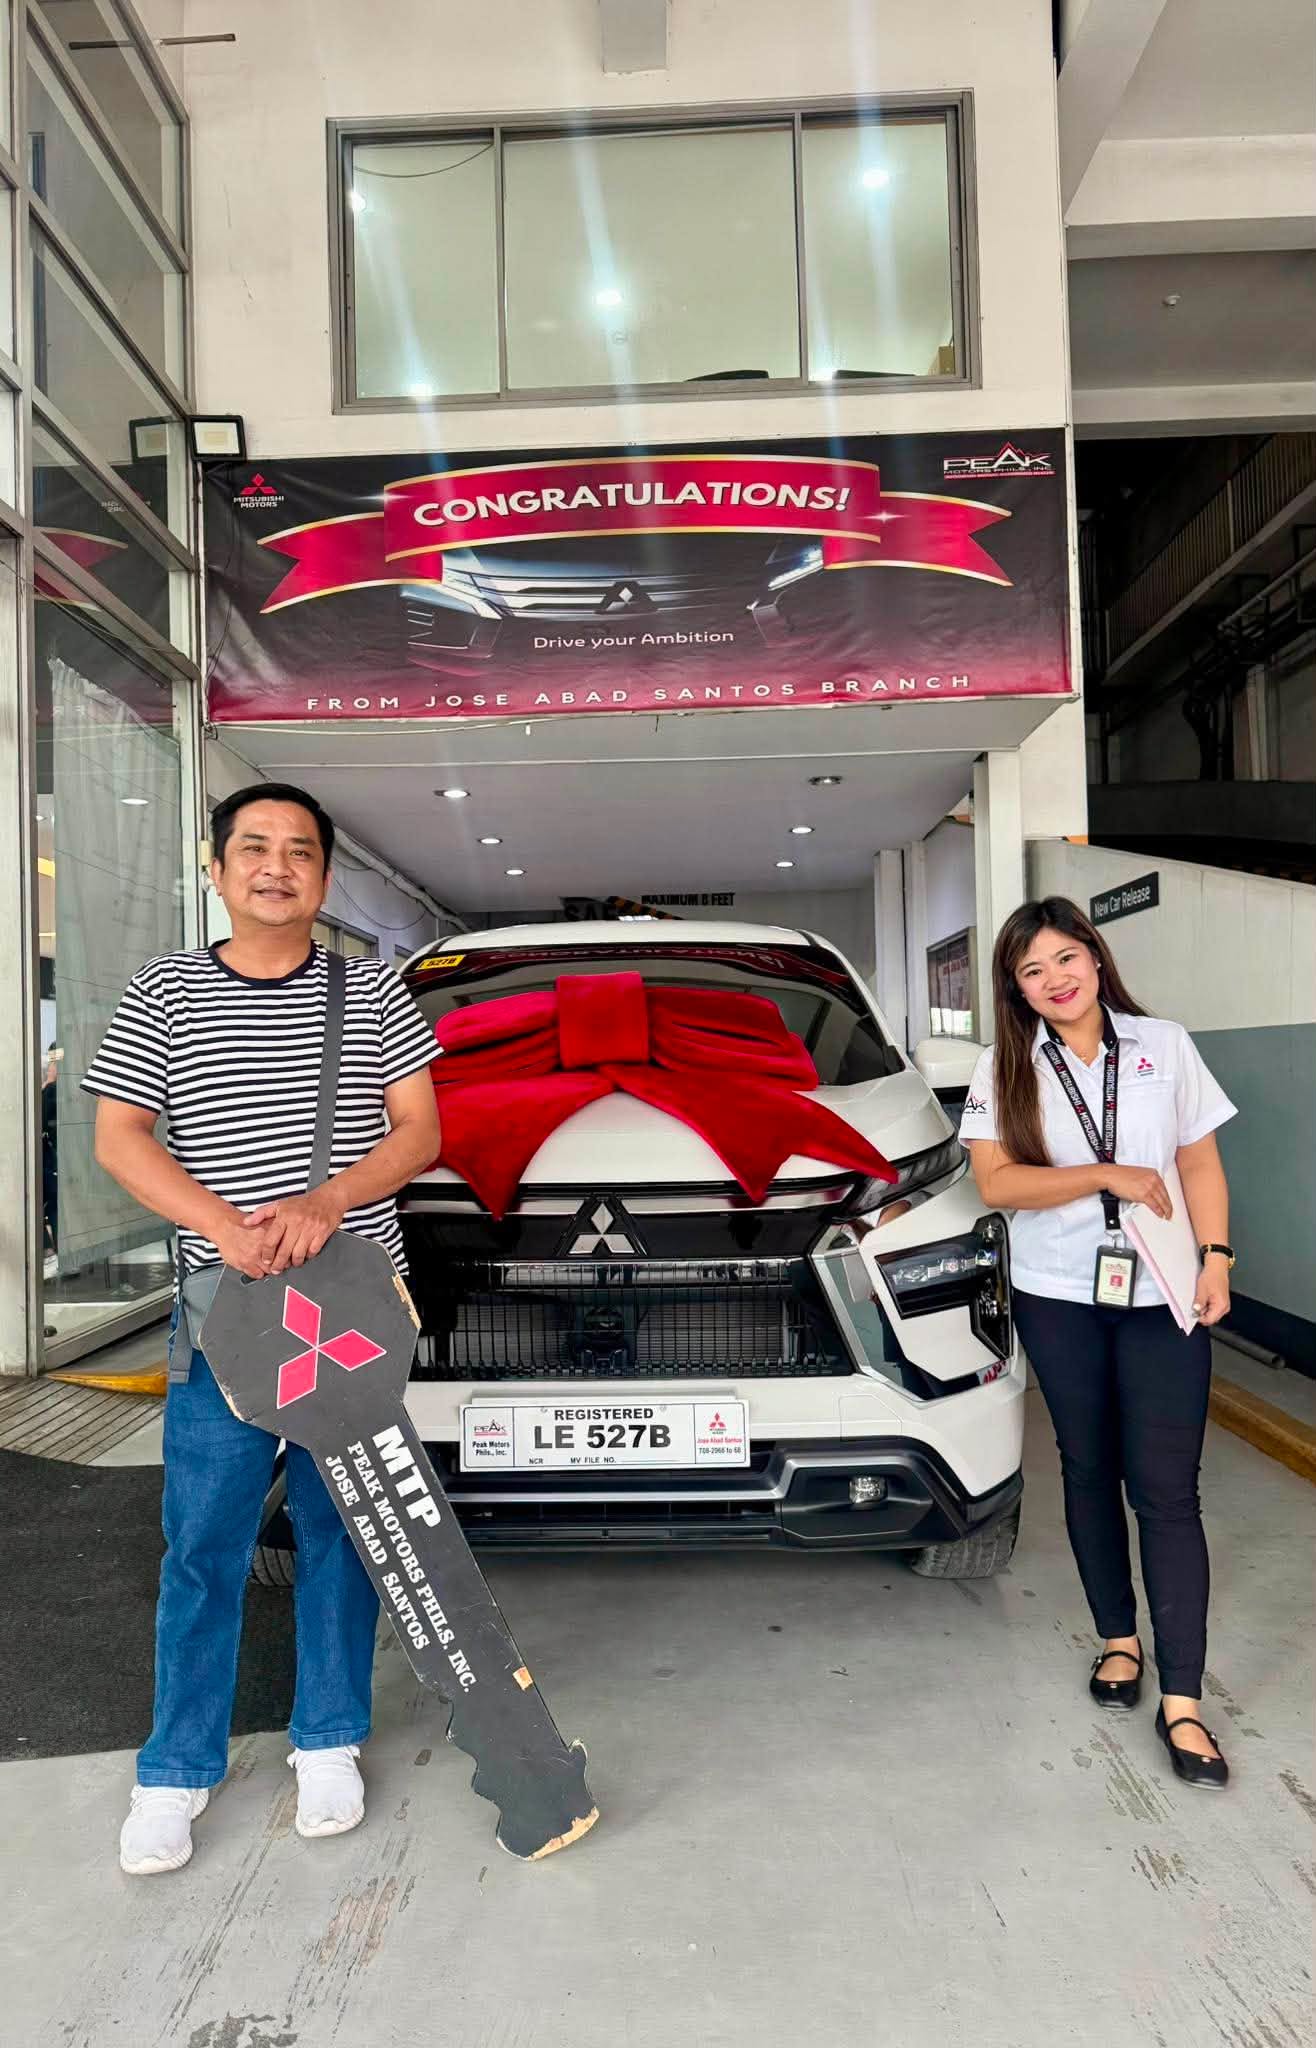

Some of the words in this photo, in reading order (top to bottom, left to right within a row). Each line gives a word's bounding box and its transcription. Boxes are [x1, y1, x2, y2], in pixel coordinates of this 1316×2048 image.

[943, 448, 1052, 471] PEAK
[233, 495, 285, 503] MITSUBISHI
[240, 501, 278, 509] MOTORS
[413, 481, 850, 527] CONGRATULATIONS!
[534, 635, 585, 649] Drive
[590, 636, 636, 649] your
[641, 631, 734, 646] Ambition
[307, 695, 399, 711] FROM
[425, 692, 509, 707] JOSE
[534, 689, 627, 705] ABAD
[654, 683, 796, 701] SANTOS
[821, 675, 970, 693] BRANCH
[641, 893, 699, 905] MAXIMUM
[711, 892, 735, 906] FEET
[1094, 902, 1109, 919] New
[1109, 896, 1121, 913] Car
[1121, 886, 1151, 909] Release
[1060, 1070, 1081, 1106] MITSUBISHI
[1105, 1063, 1117, 1101] MITSUBISHI
[1080, 1111, 1101, 1152] MITSUBISHI
[1104, 1110, 1115, 1151] MITSUBISHI
[554, 1408, 654, 1421] REGISTERED
[534, 1424, 575, 1449] LE
[587, 1424, 671, 1449] 527B
[372, 1424, 441, 1528] MTP
[584, 1456, 600, 1464] FILE
[603, 1456, 617, 1464] NO.
[325, 1455, 361, 1507] JOSE
[353, 1513, 388, 1565] ABAD
[381, 1571, 430, 1650] SANTOS
[347, 1441, 384, 1499] PEAK
[373, 1496, 426, 1584] MOTORS
[416, 1583, 455, 1650] PHILS.
[448, 1649, 478, 1693] INC.
